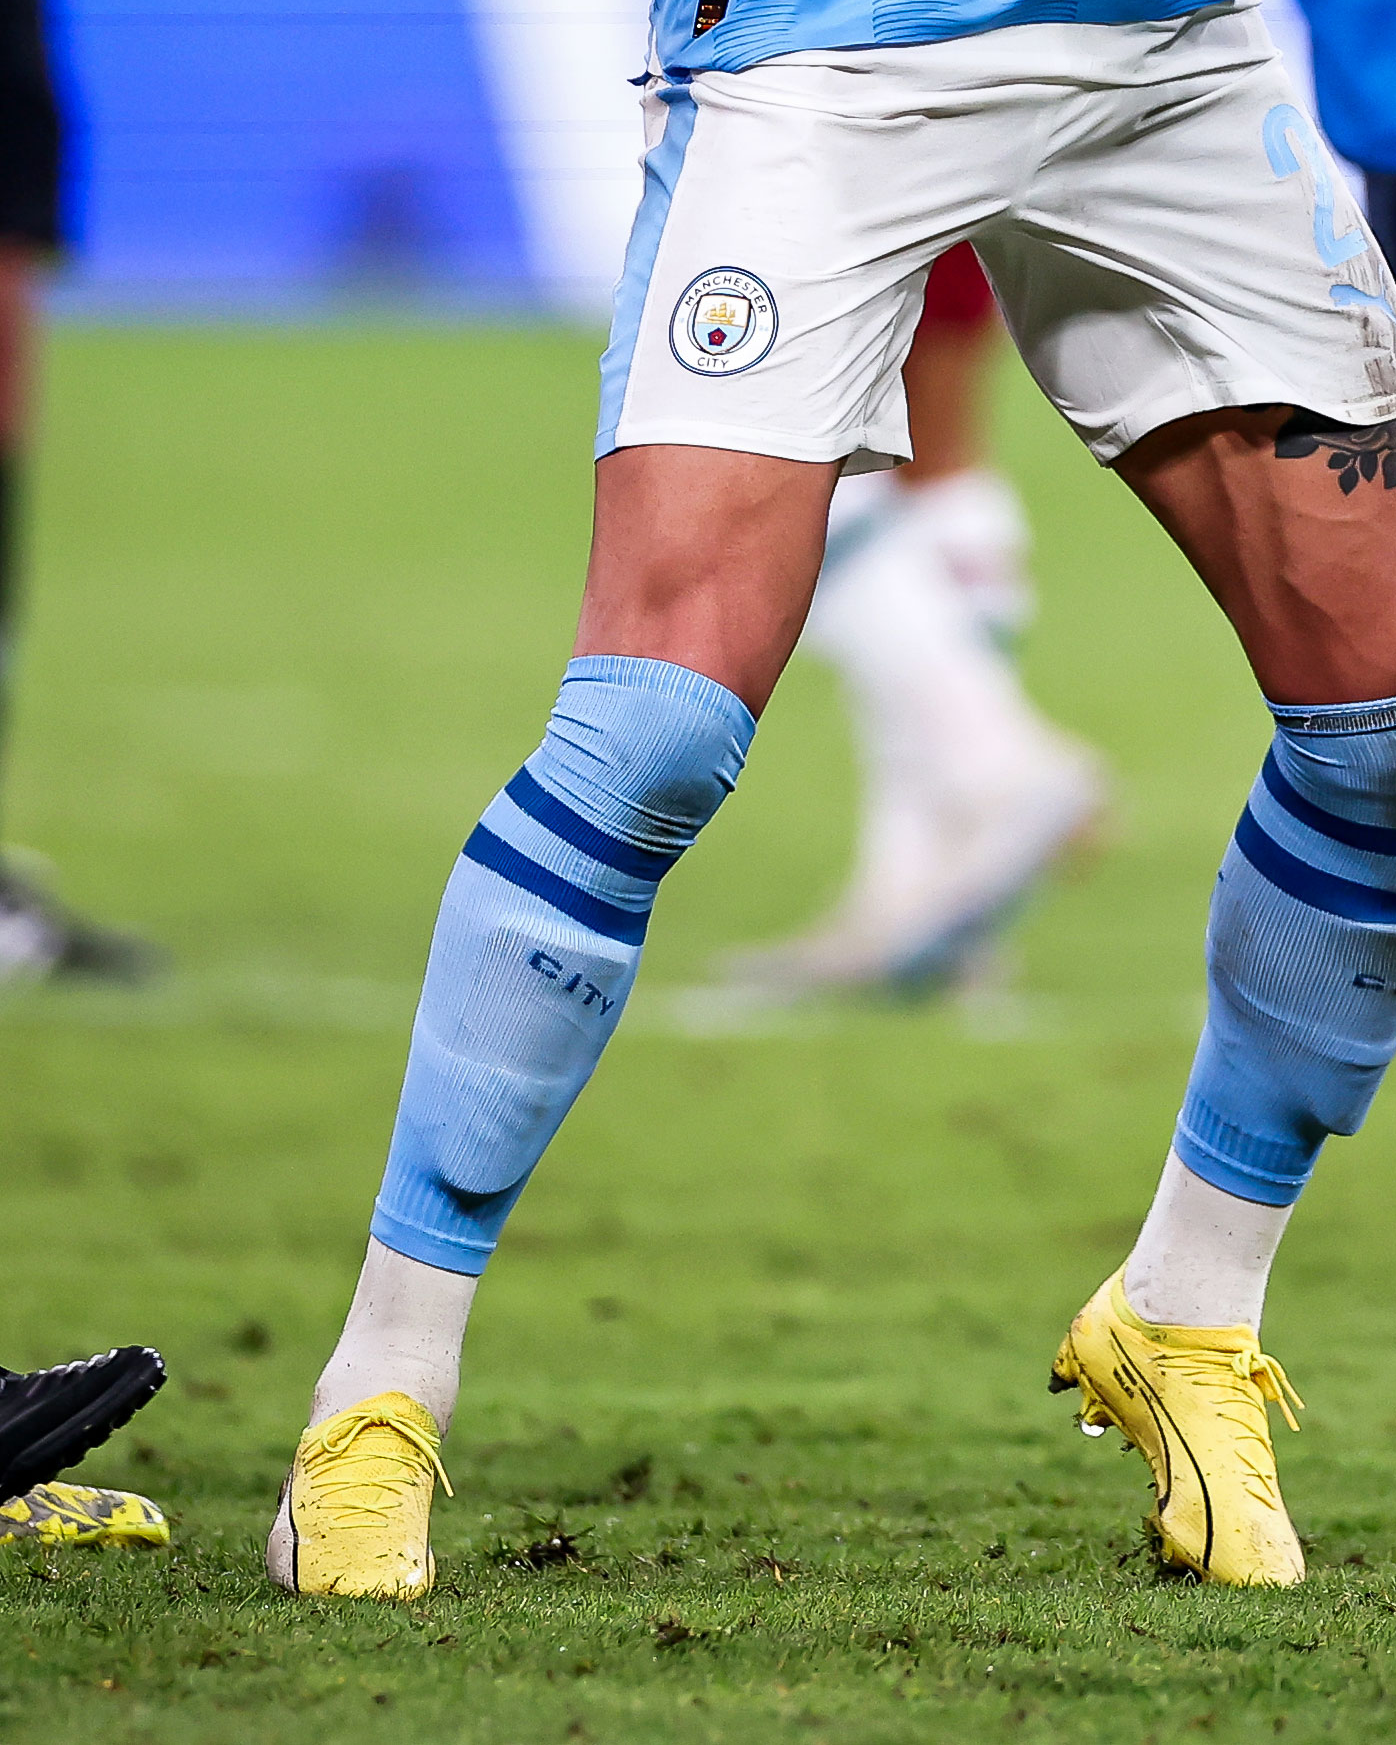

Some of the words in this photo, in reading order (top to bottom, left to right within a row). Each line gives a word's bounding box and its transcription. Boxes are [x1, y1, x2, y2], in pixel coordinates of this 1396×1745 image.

[1262, 104, 1369, 268] 2
[684, 275, 768, 314] MANCHESTER
[697, 357, 729, 369] CITY
[528, 948, 615, 1015] CITY
